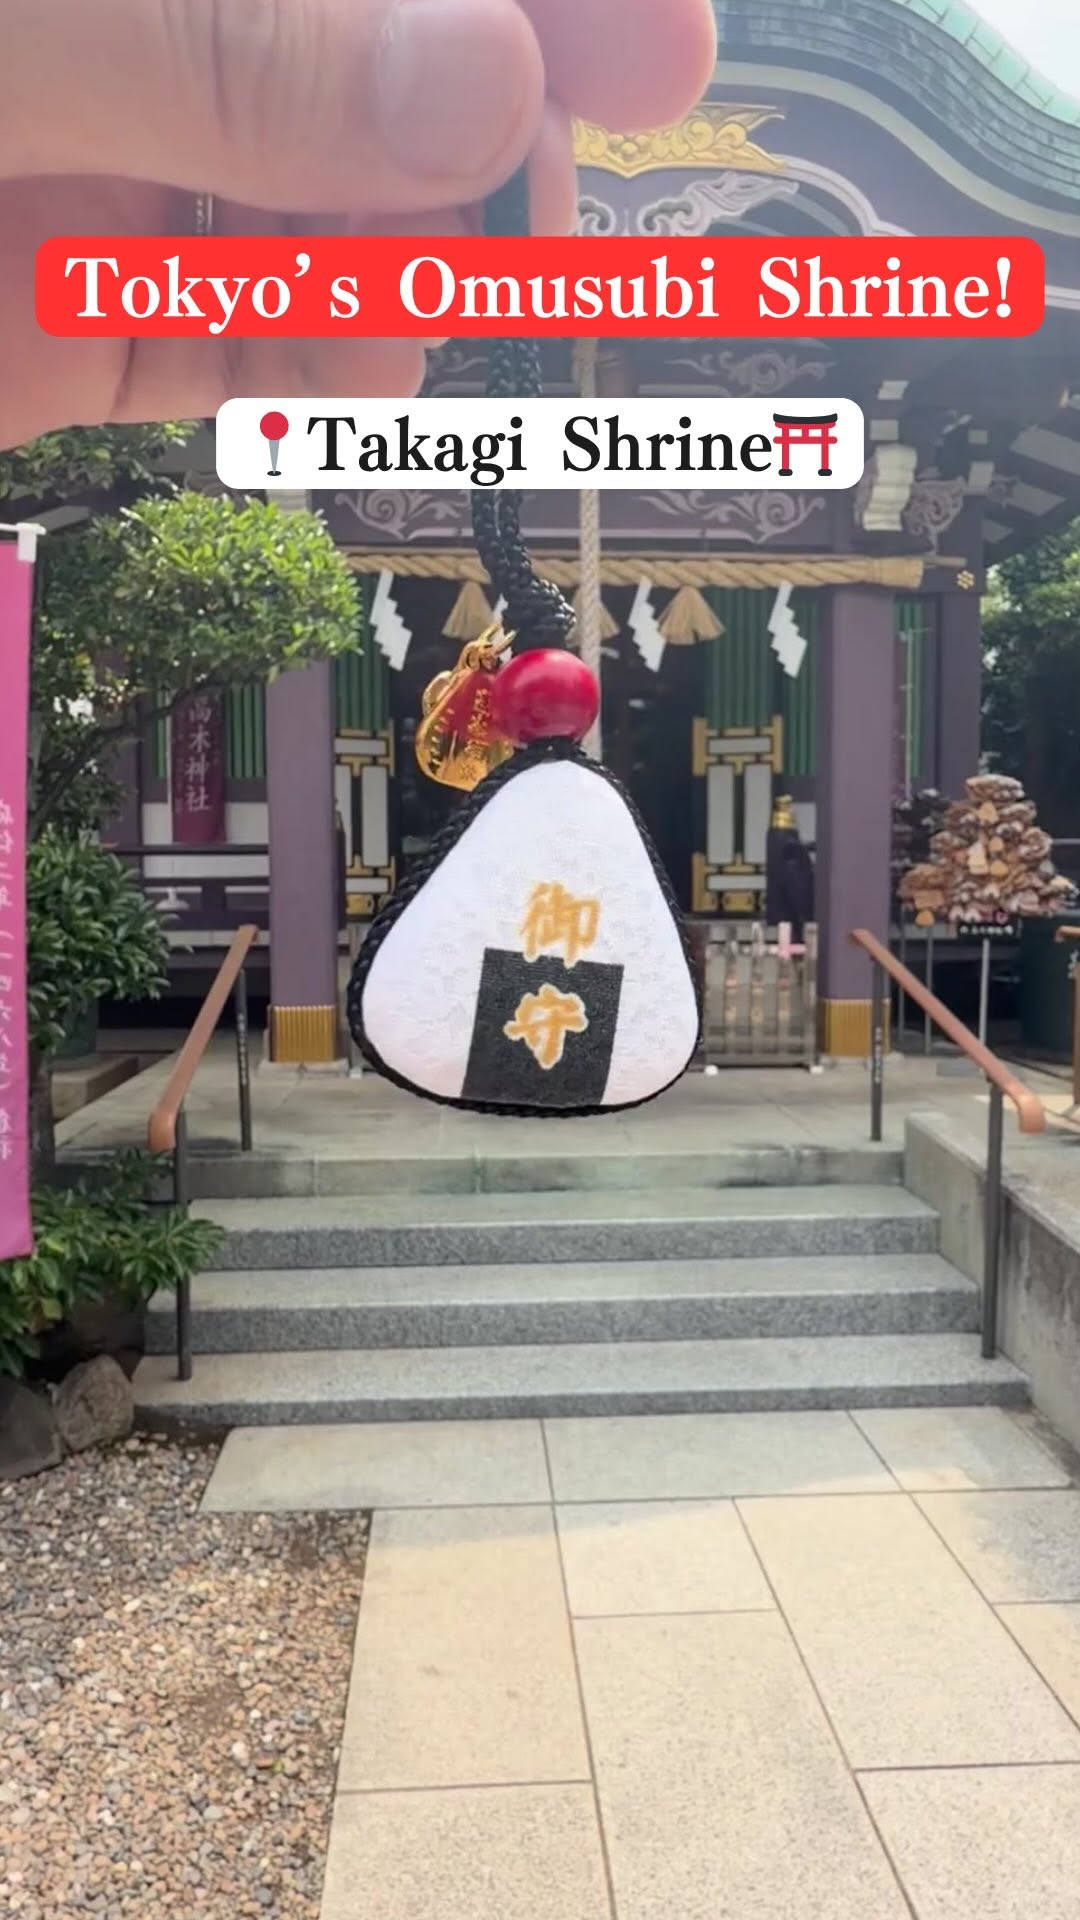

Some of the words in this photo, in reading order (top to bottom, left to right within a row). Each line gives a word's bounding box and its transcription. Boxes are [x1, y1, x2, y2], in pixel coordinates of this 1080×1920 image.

[184, 696, 213, 813] 高木神社
[503, 881, 601, 1069] 御守
